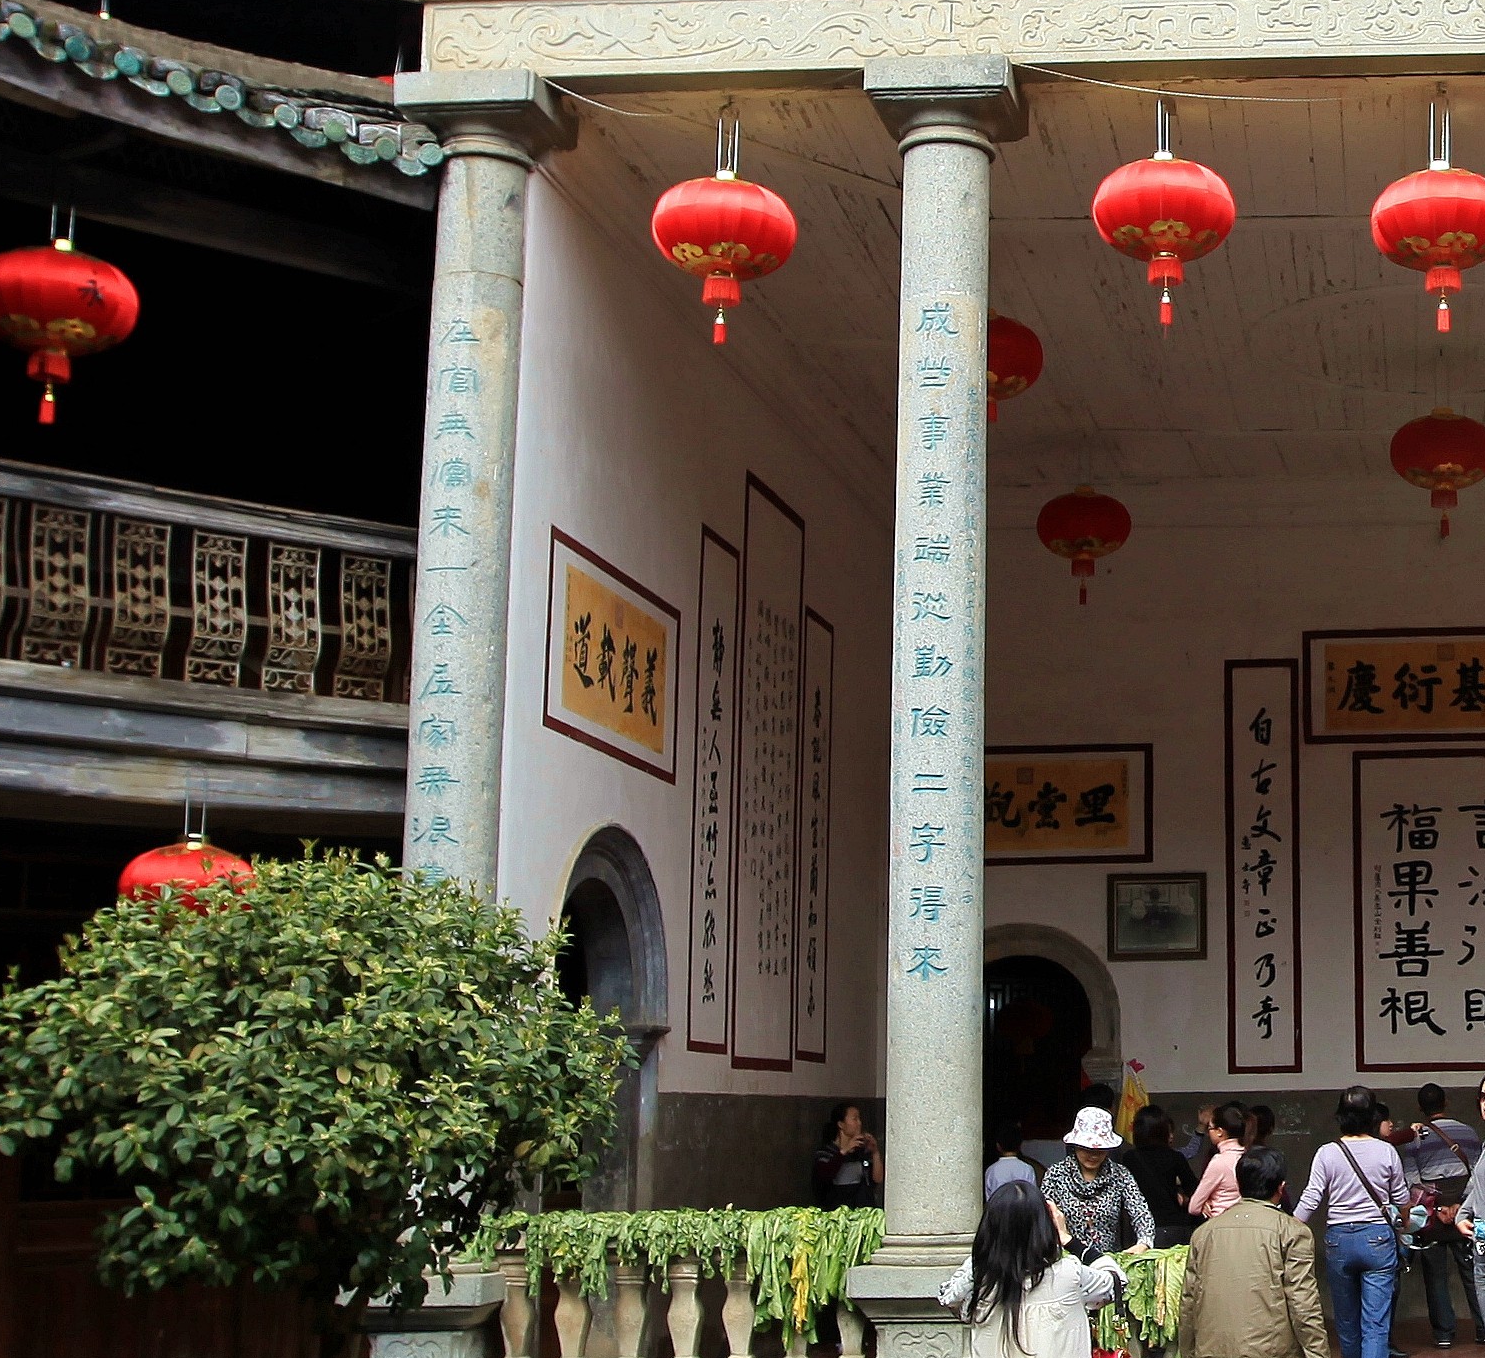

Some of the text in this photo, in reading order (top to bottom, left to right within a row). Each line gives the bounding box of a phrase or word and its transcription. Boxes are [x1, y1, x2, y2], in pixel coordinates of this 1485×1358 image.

[574, 612, 657, 726] 義聲載道
[1378, 803, 1447, 1036] 福果善根
